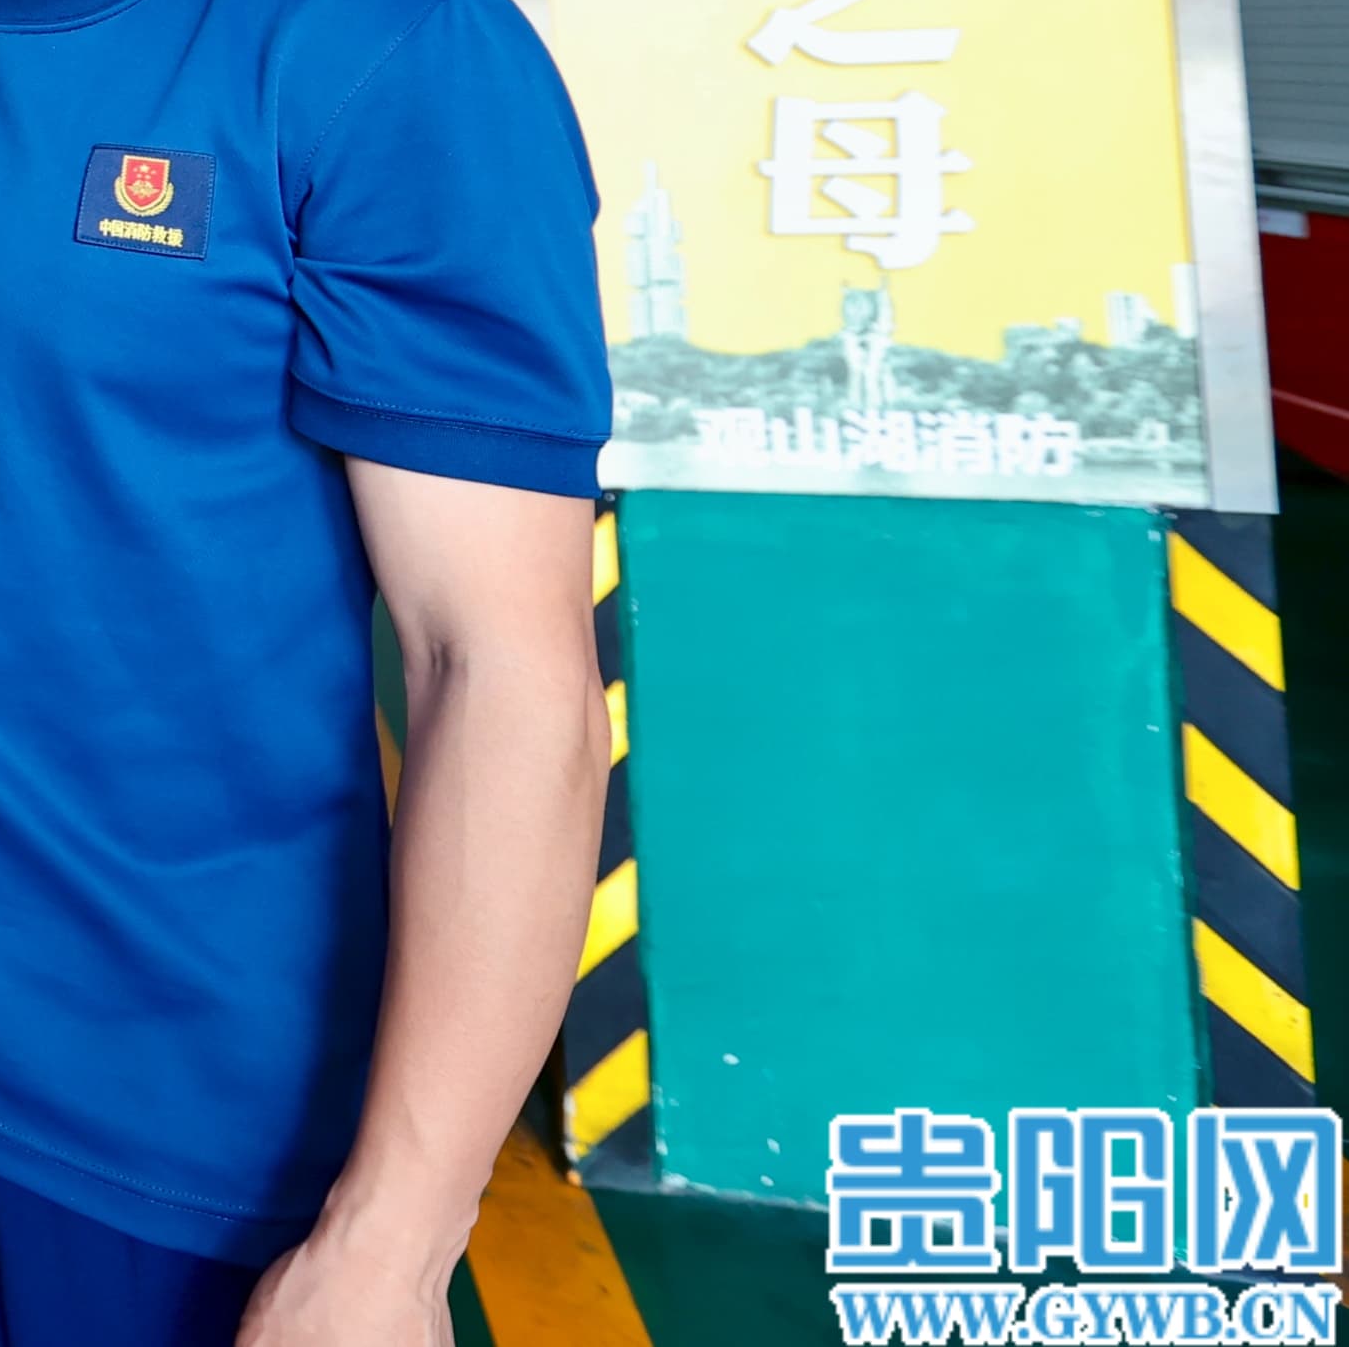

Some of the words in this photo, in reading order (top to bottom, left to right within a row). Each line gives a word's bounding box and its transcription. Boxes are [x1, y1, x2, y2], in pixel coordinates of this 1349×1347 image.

[99, 219, 184, 247] 中国消防救援
[696, 405, 1081, 478] 观山湖消防
